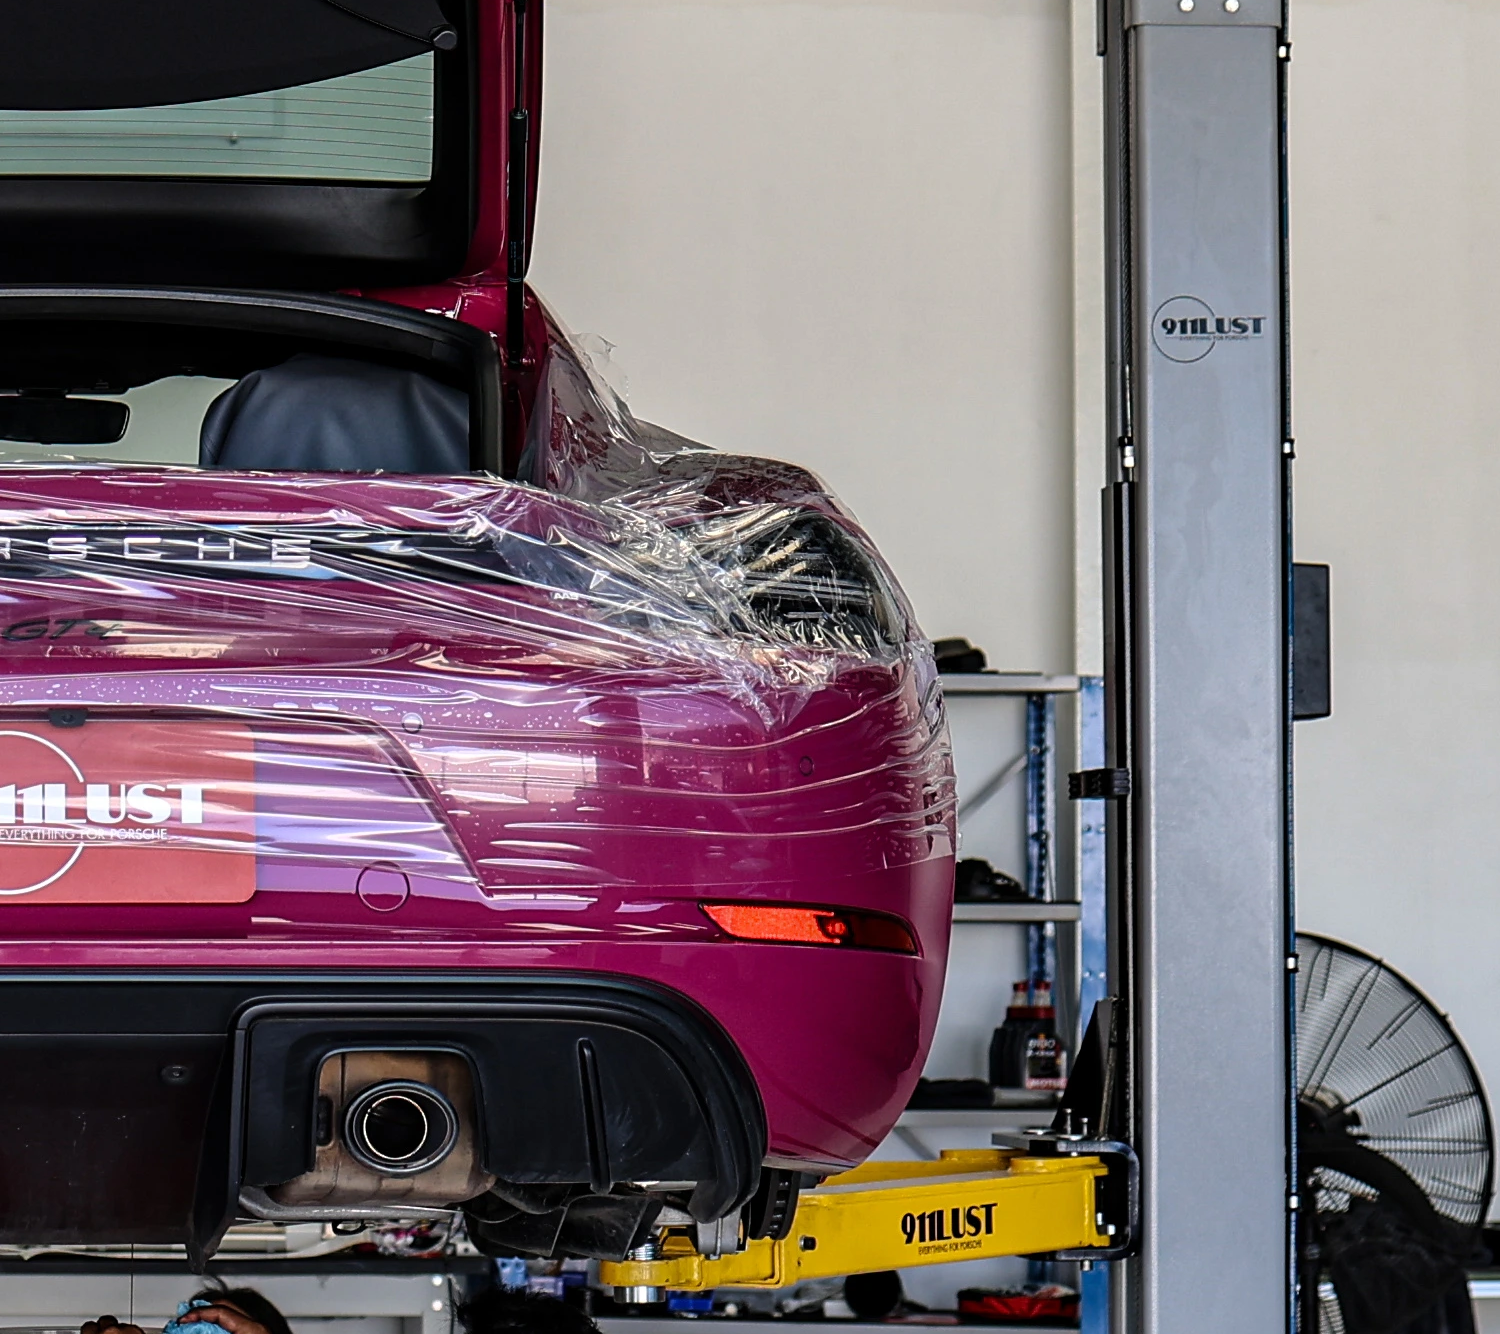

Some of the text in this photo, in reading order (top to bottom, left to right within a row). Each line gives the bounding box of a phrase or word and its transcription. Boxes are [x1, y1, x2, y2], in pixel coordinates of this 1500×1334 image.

[1161, 317, 1267, 335] 911LUST
[2, 619, 123, 641] GT4
[80, 828, 106, 841] FOR
[109, 828, 168, 841] PORSCHE
[901, 1202, 999, 1245] 911LUST
